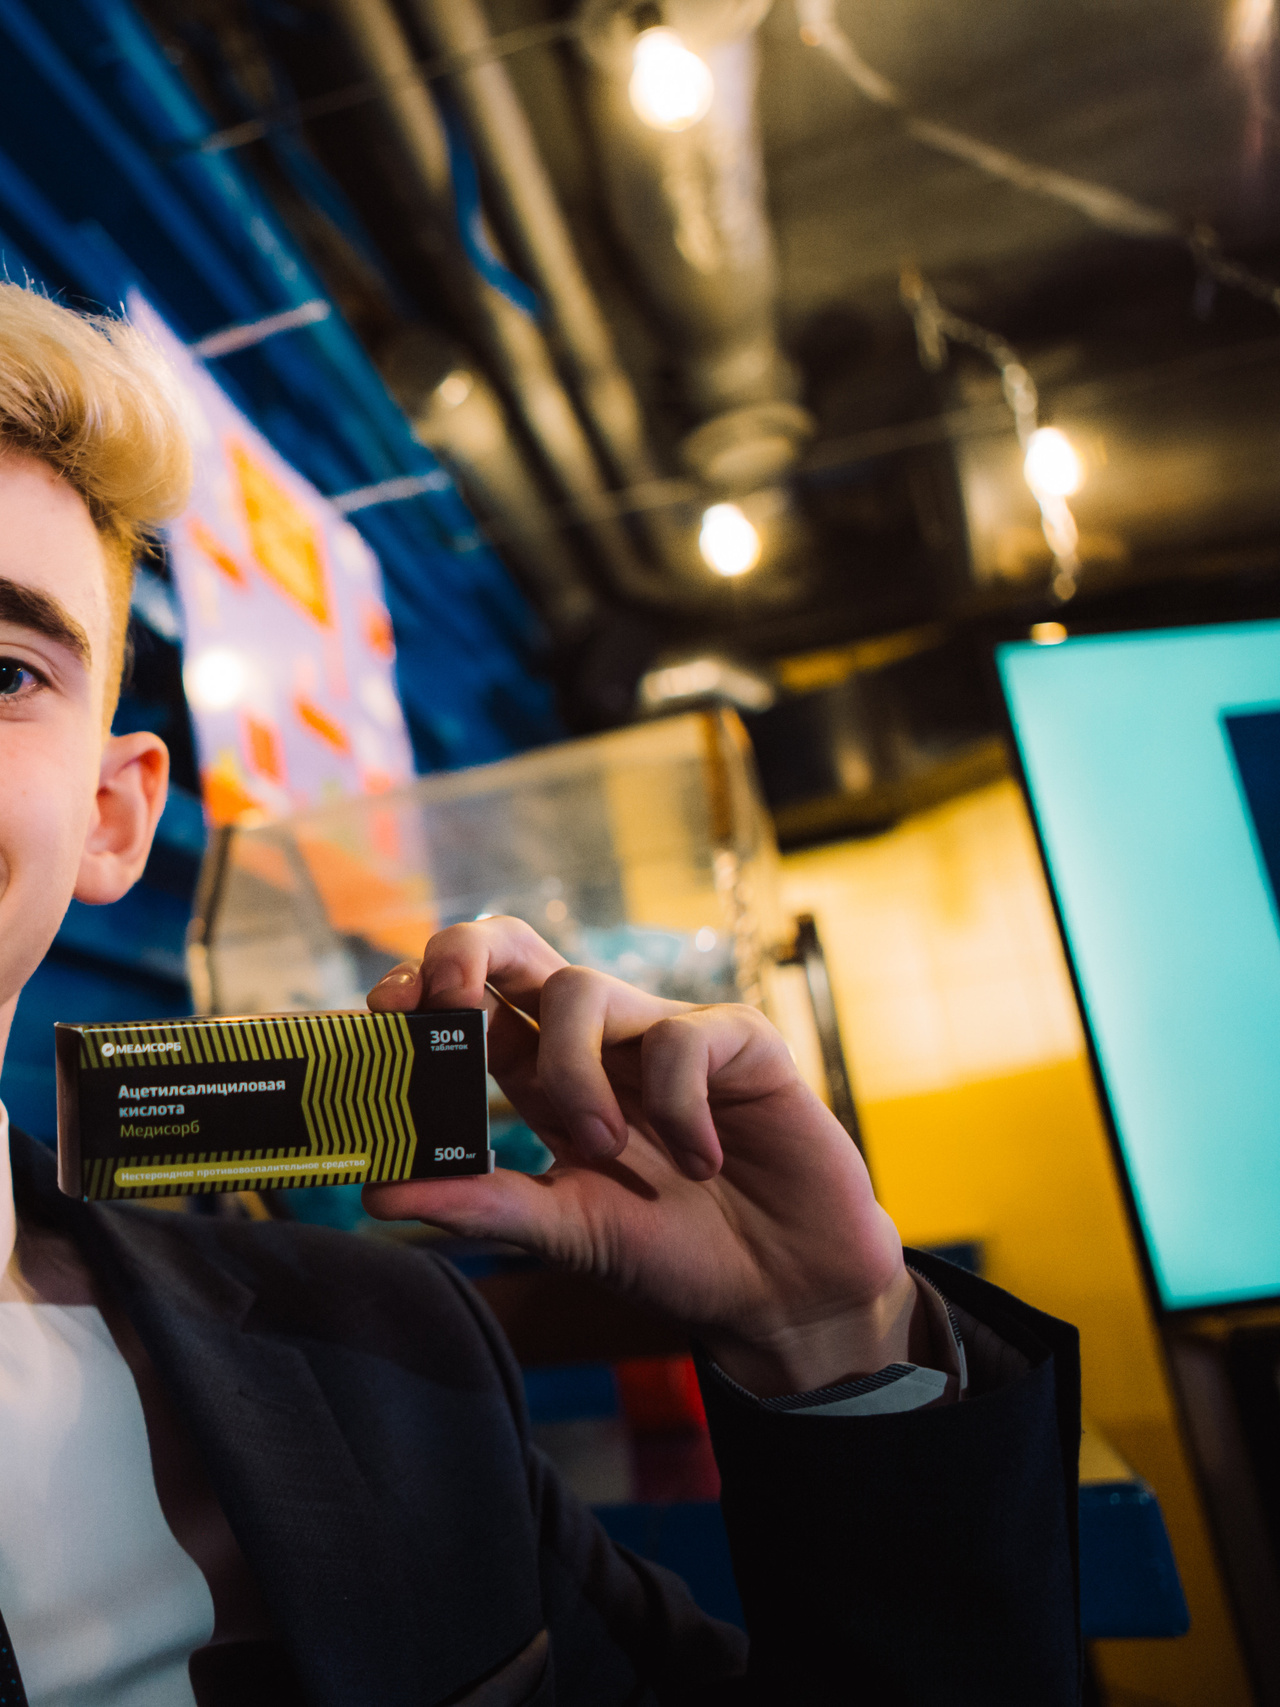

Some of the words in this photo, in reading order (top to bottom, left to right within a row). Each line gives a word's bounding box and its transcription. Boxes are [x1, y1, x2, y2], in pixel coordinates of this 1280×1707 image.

[430, 1030, 451, 1044] 30
[116, 1042, 182, 1054] МЕДИСОРБ
[430, 1043, 468, 1052] таблеток
[118, 1080, 286, 1101] Ацетилсалициловая
[119, 1103, 185, 1118] кислота
[120, 1120, 200, 1139] Медисорб
[121, 1169, 194, 1181] Нестероидное
[197, 1163, 320, 1177] противовоспалительное
[322, 1159, 366, 1170] средство
